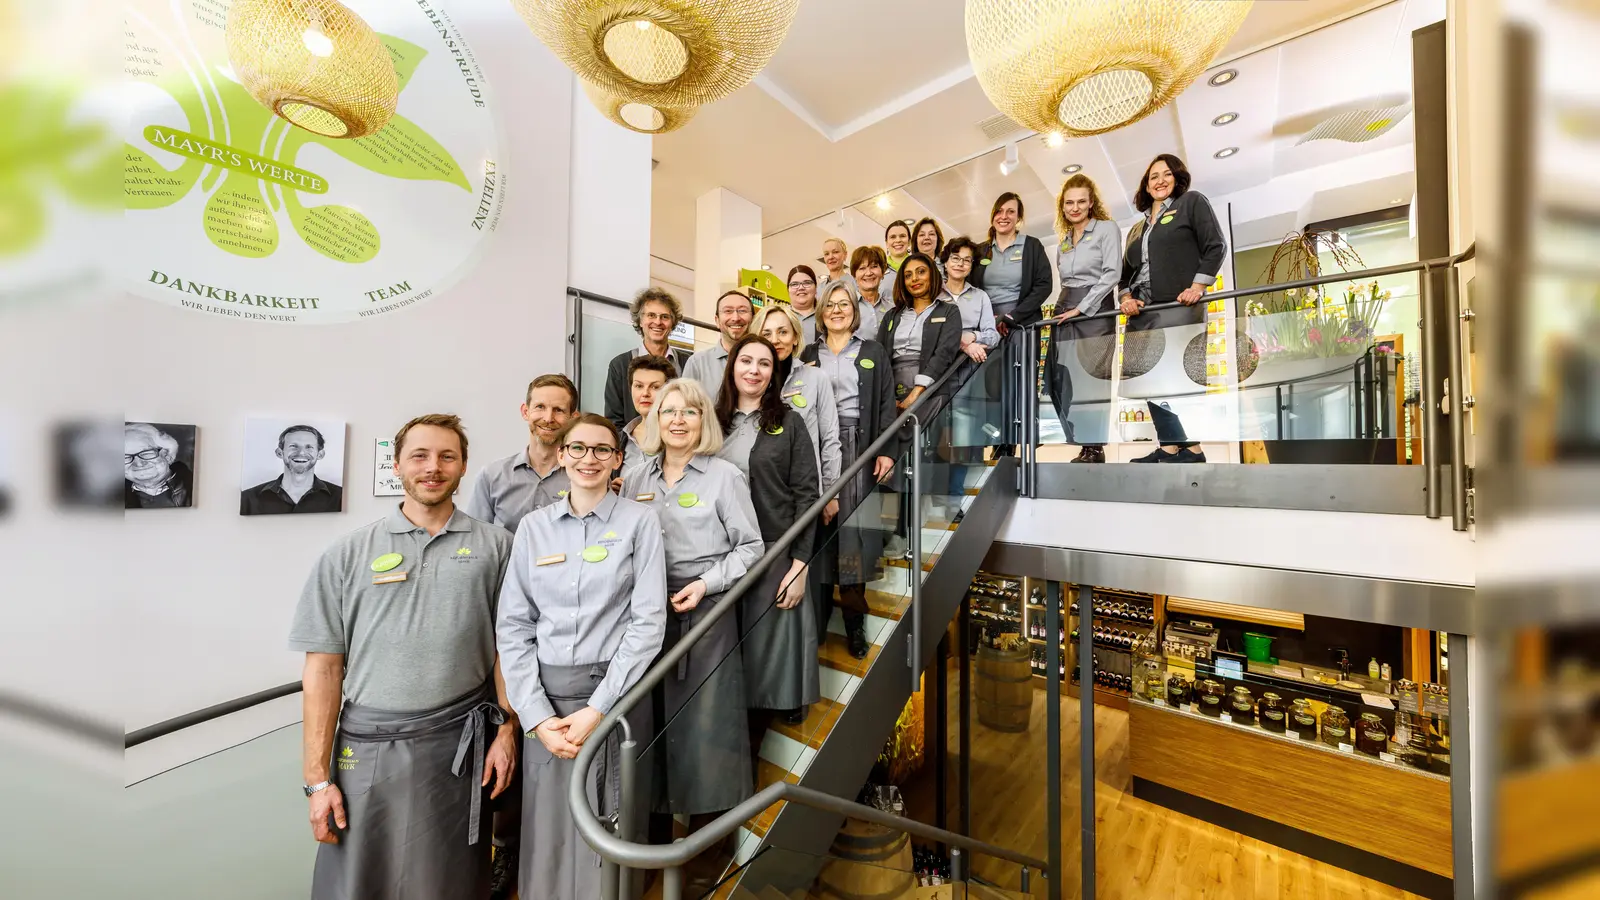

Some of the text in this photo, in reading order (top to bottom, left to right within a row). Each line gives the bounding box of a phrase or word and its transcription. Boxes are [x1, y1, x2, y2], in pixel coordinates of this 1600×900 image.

[154, 129, 322, 191] MAYR'S WERTE
[232, 191, 260, 204] indem
[471, 160, 496, 231] EXZELLENZ
[209, 206, 236, 217] außen
[216, 198, 268, 216] wir ihn nach
[207, 215, 263, 233] machen und
[349, 213, 370, 227] durch
[209, 226, 274, 245] wertschätzend
[218, 239, 266, 253] annehmen.
[302, 225, 343, 249] freundliche
[148, 269, 320, 310] DANKBARKEIT
[364, 280, 412, 303] TEAM
[181, 299, 297, 322] WIR LEBEN DEN WERT
[358, 289, 433, 318] WIR LEBEN DEN WERT
